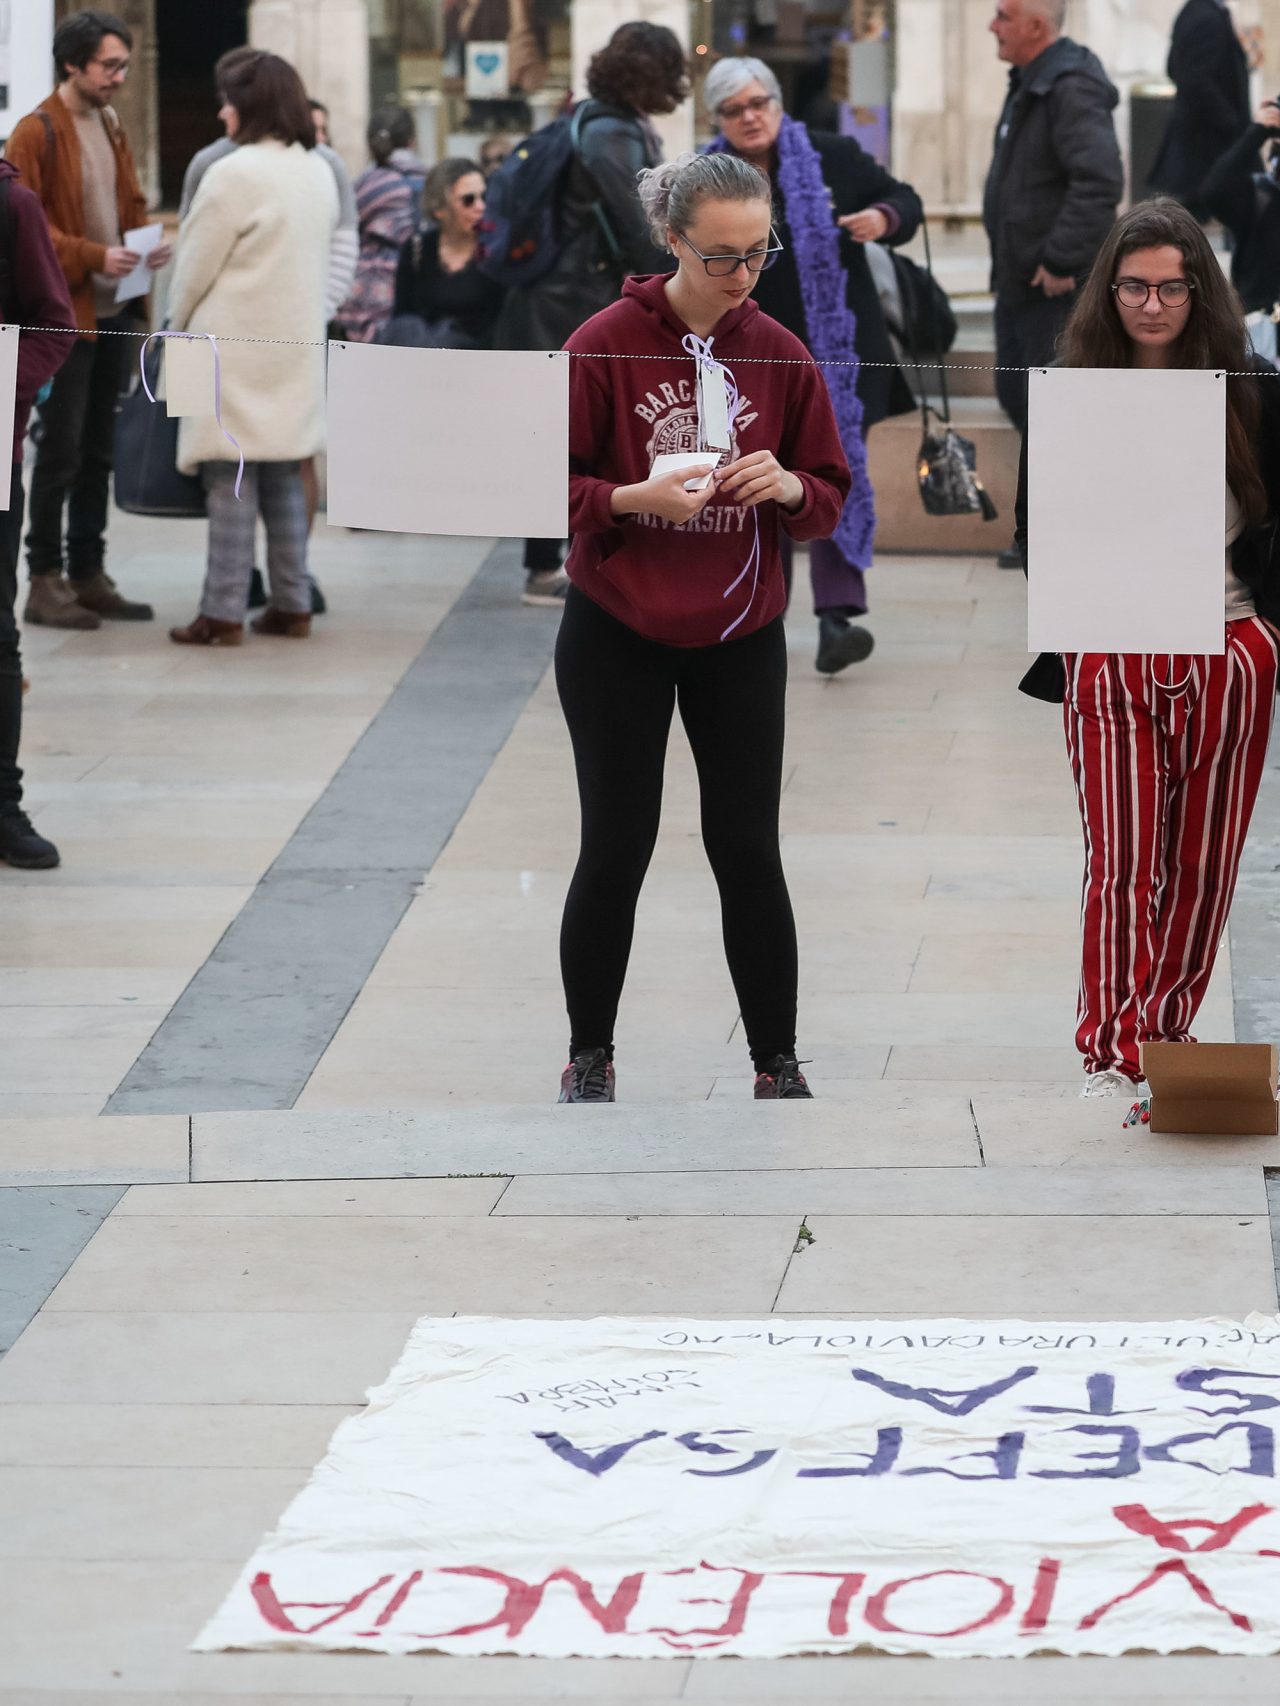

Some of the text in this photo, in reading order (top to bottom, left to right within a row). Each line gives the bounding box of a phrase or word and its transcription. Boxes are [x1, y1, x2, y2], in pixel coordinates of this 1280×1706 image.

[634, 379, 759, 433] BARCNA
[655, 416, 694, 455] ARCELONA
[632, 505, 748, 533] NIVRSITY
